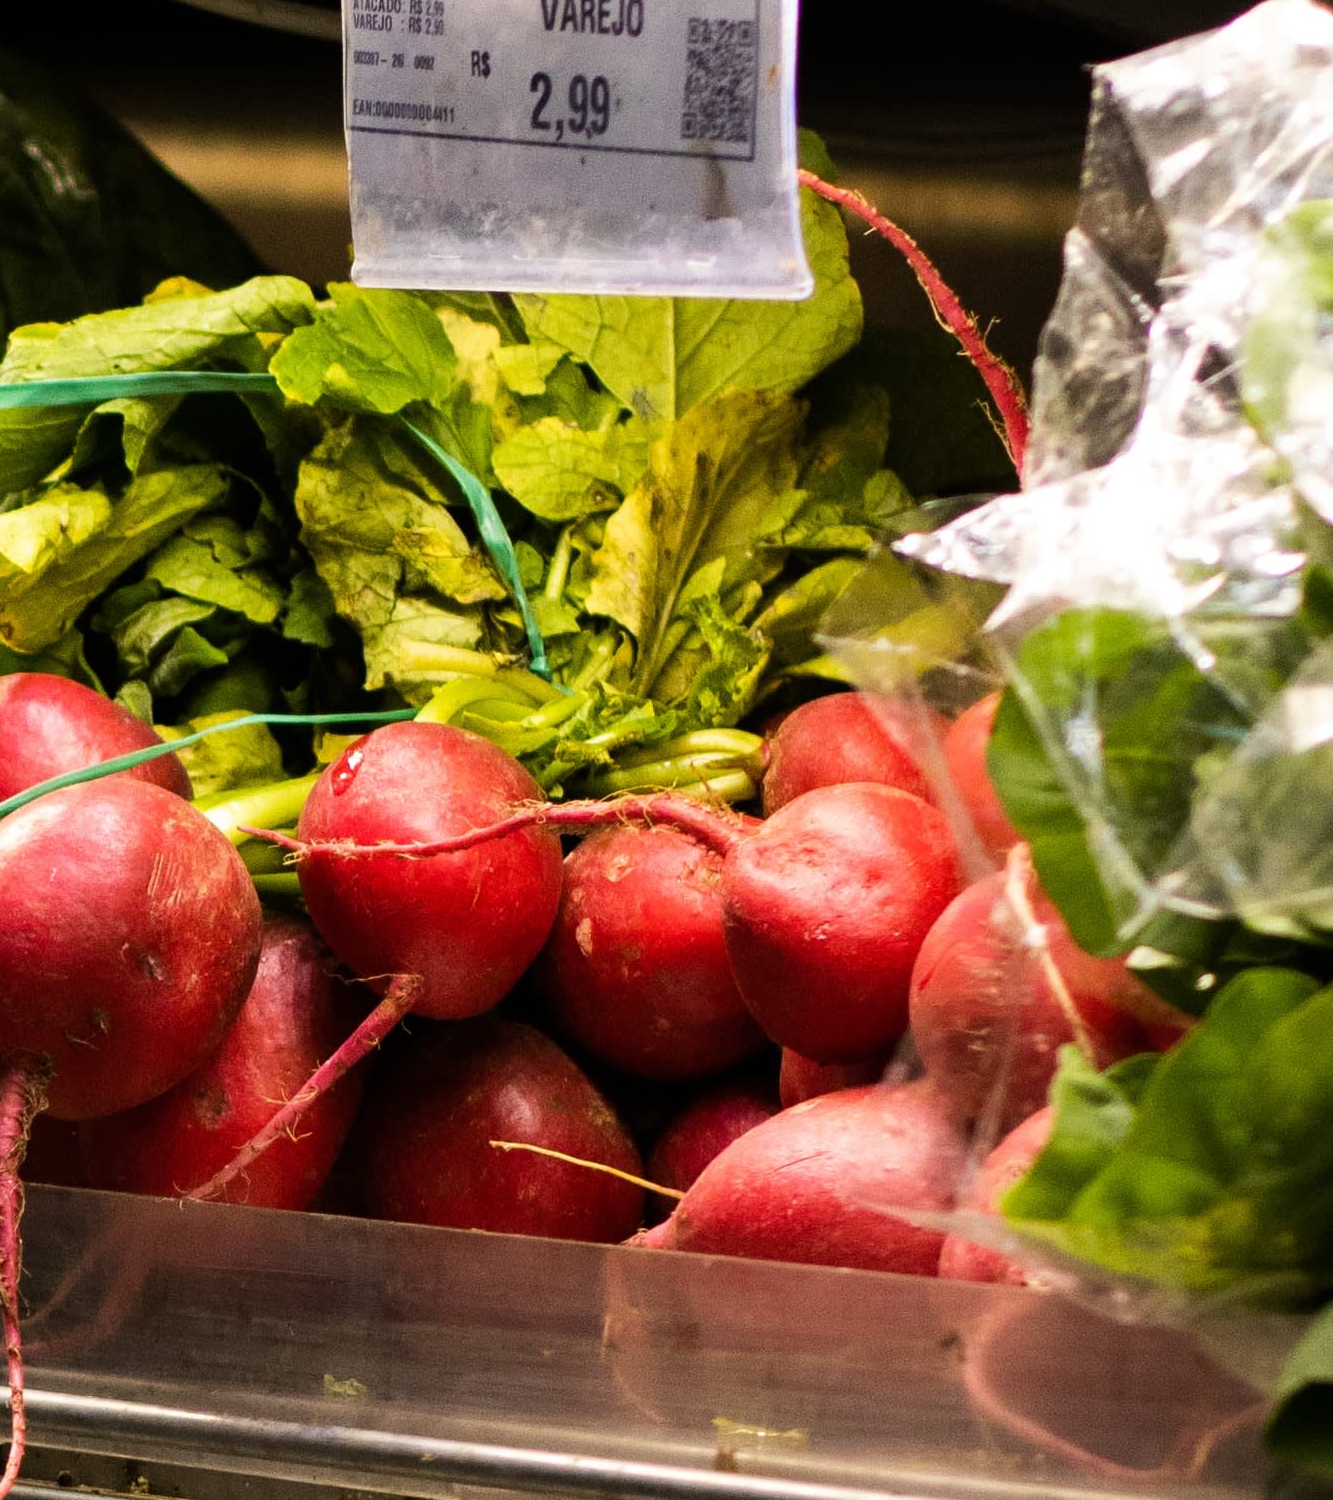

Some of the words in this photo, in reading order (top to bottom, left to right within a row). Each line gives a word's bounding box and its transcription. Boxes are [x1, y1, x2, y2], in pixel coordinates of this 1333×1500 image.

[353, 14, 393, 31] VAREJO
[408, 17, 422, 33] R$
[471, 51, 491, 78] R$
[529, 71, 611, 141] 2,99
